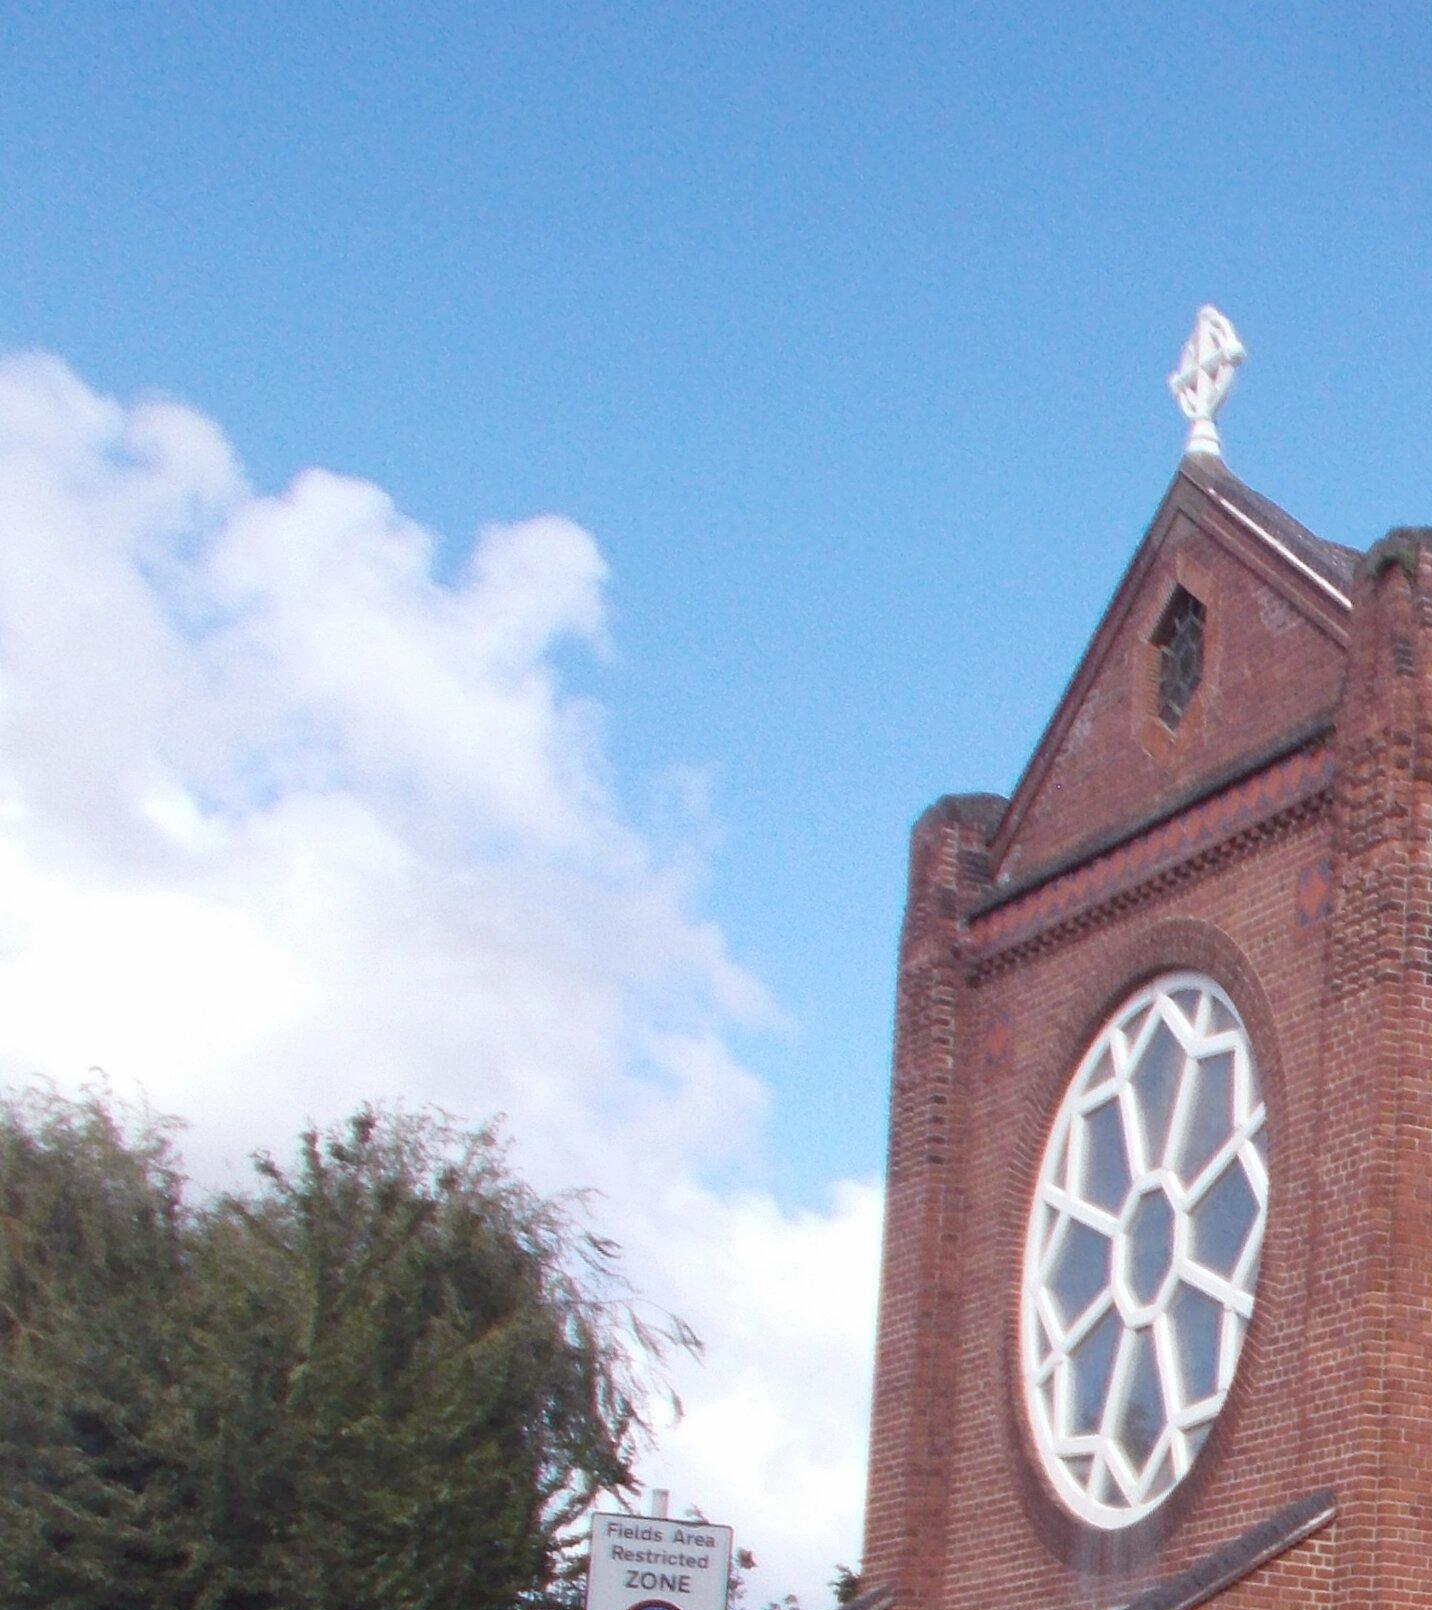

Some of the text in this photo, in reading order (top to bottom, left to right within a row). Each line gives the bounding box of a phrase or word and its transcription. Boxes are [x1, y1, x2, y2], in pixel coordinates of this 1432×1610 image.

[607, 1522, 716, 1548] Fields Area
[611, 1544, 709, 1569] Restricted
[625, 1570, 691, 1593] ZONE
